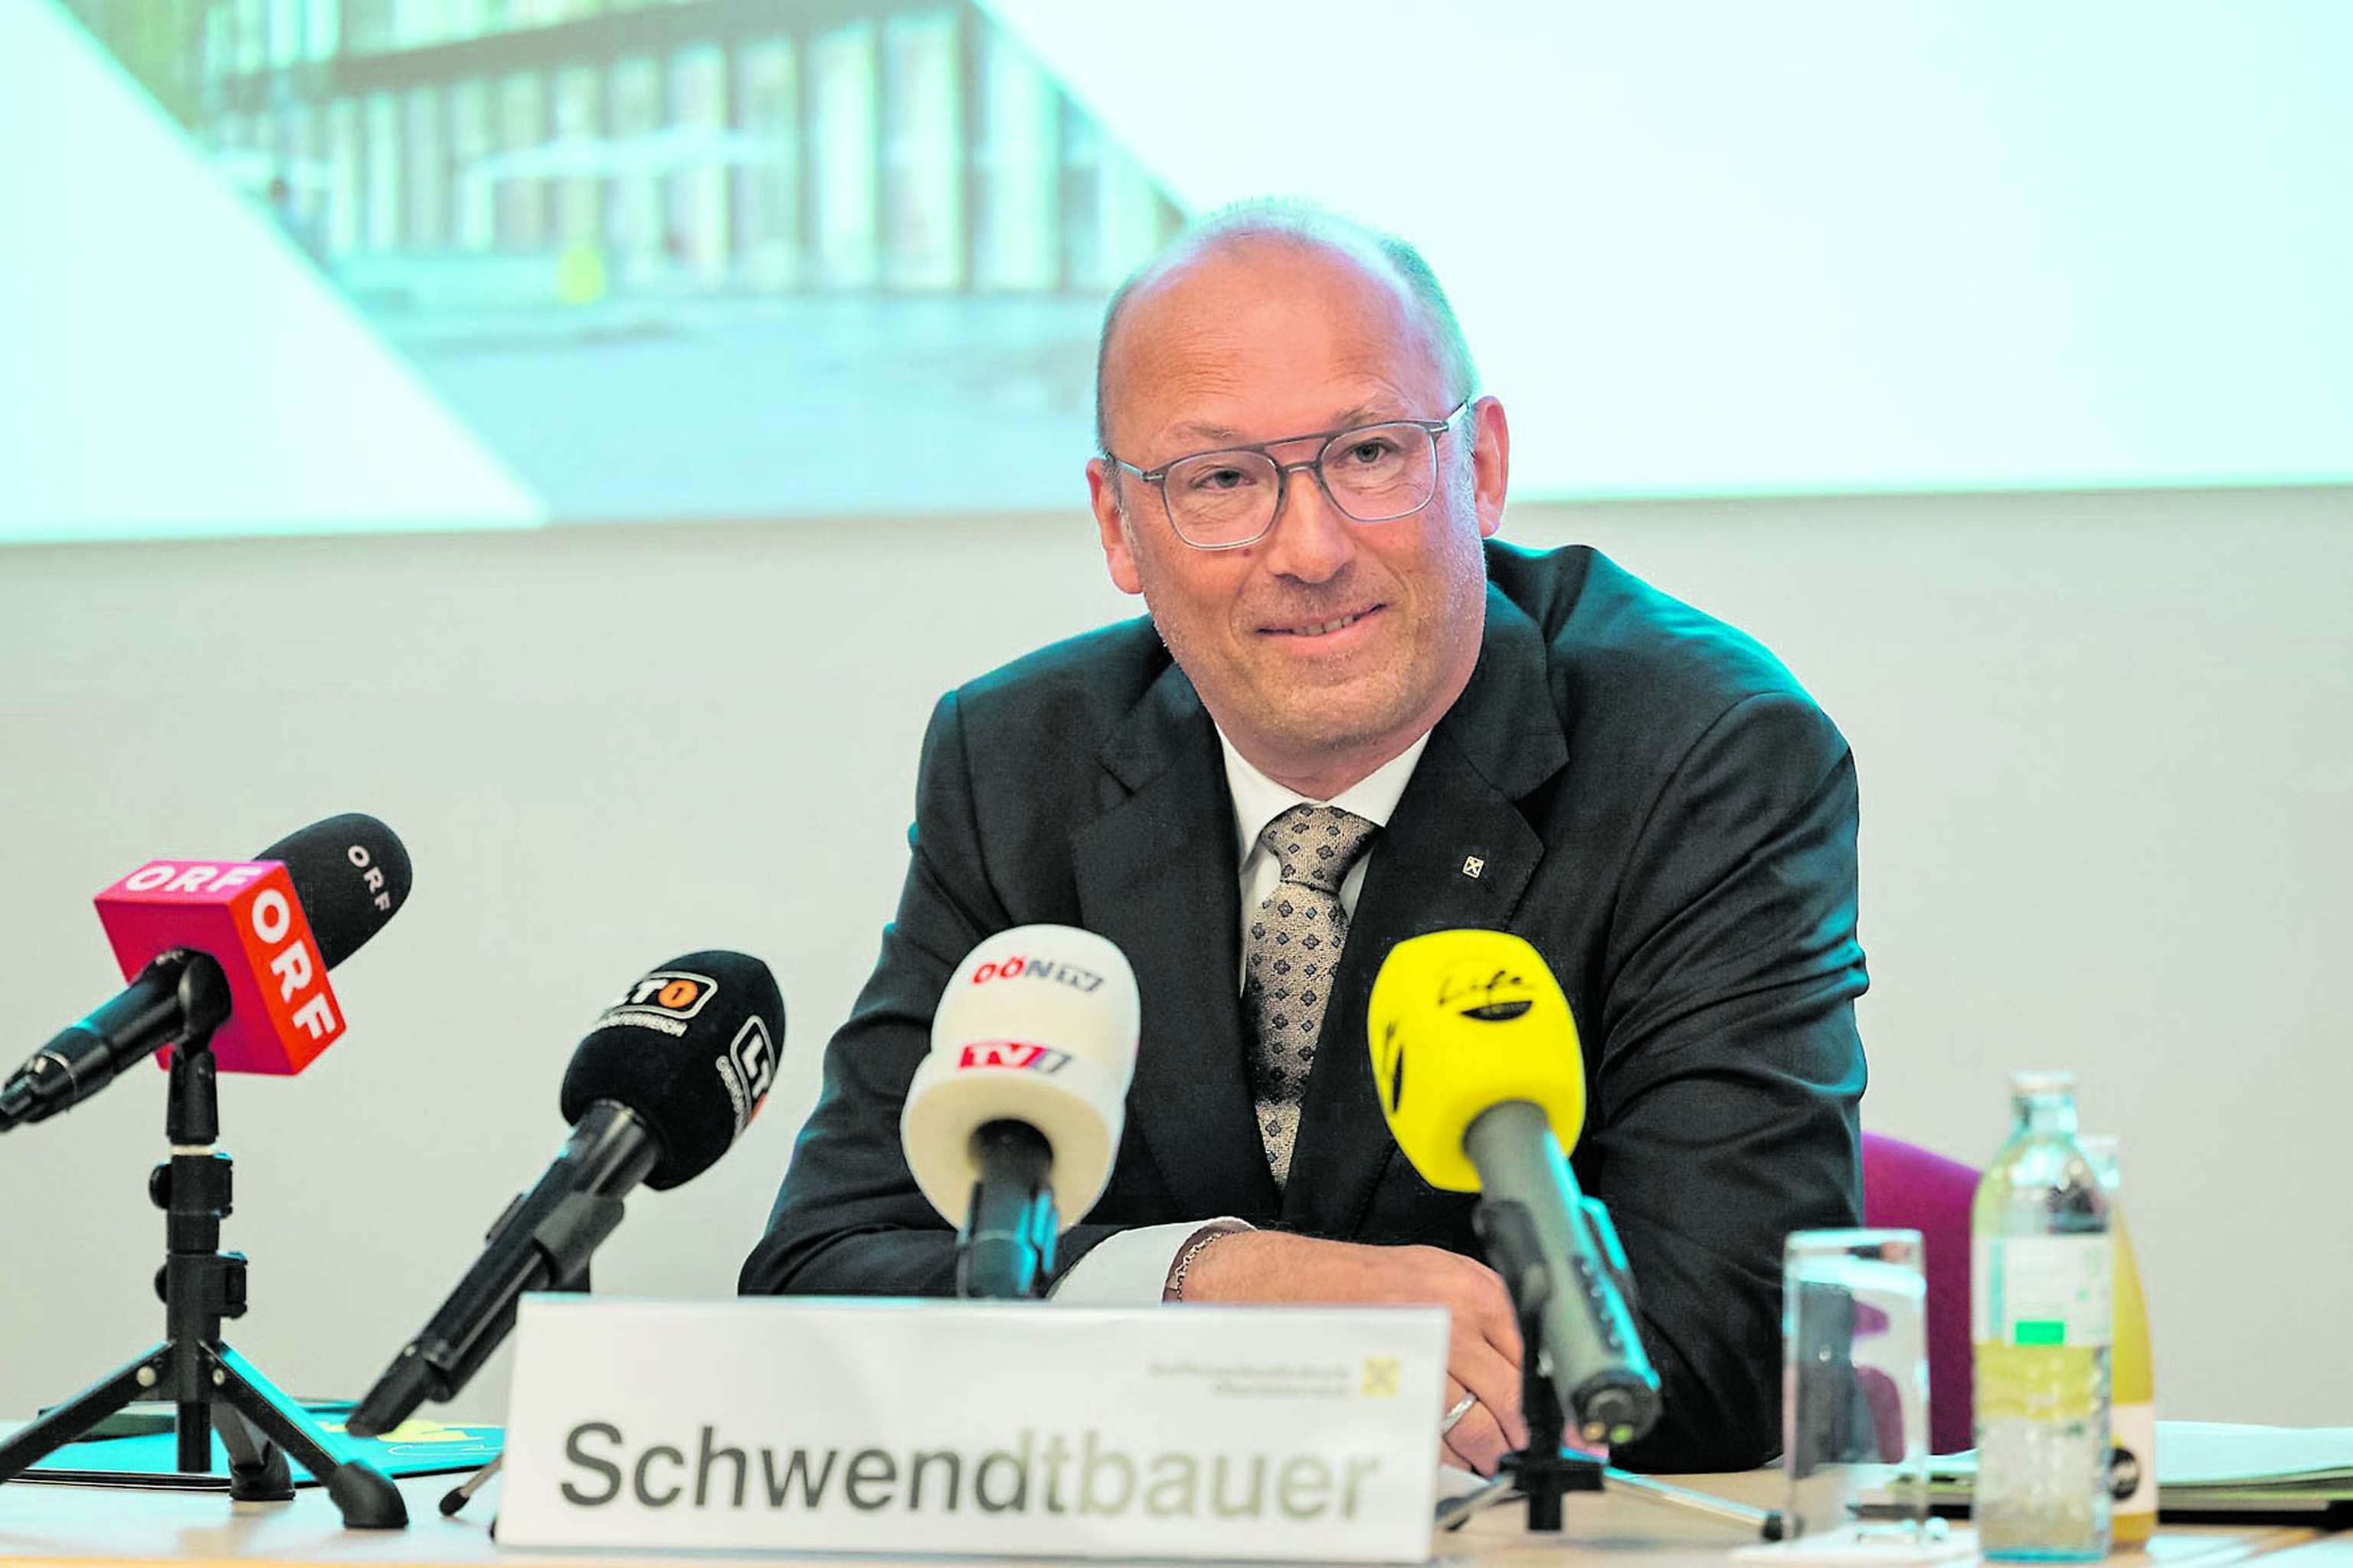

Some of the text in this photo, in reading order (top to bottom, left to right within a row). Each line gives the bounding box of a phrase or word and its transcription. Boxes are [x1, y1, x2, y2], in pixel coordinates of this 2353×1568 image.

[125, 866, 262, 893] ORF
[347, 845, 391, 911] ORF
[252, 889, 336, 1040] ORF
[558, 1422, 1380, 1522] Schwendtbauer
